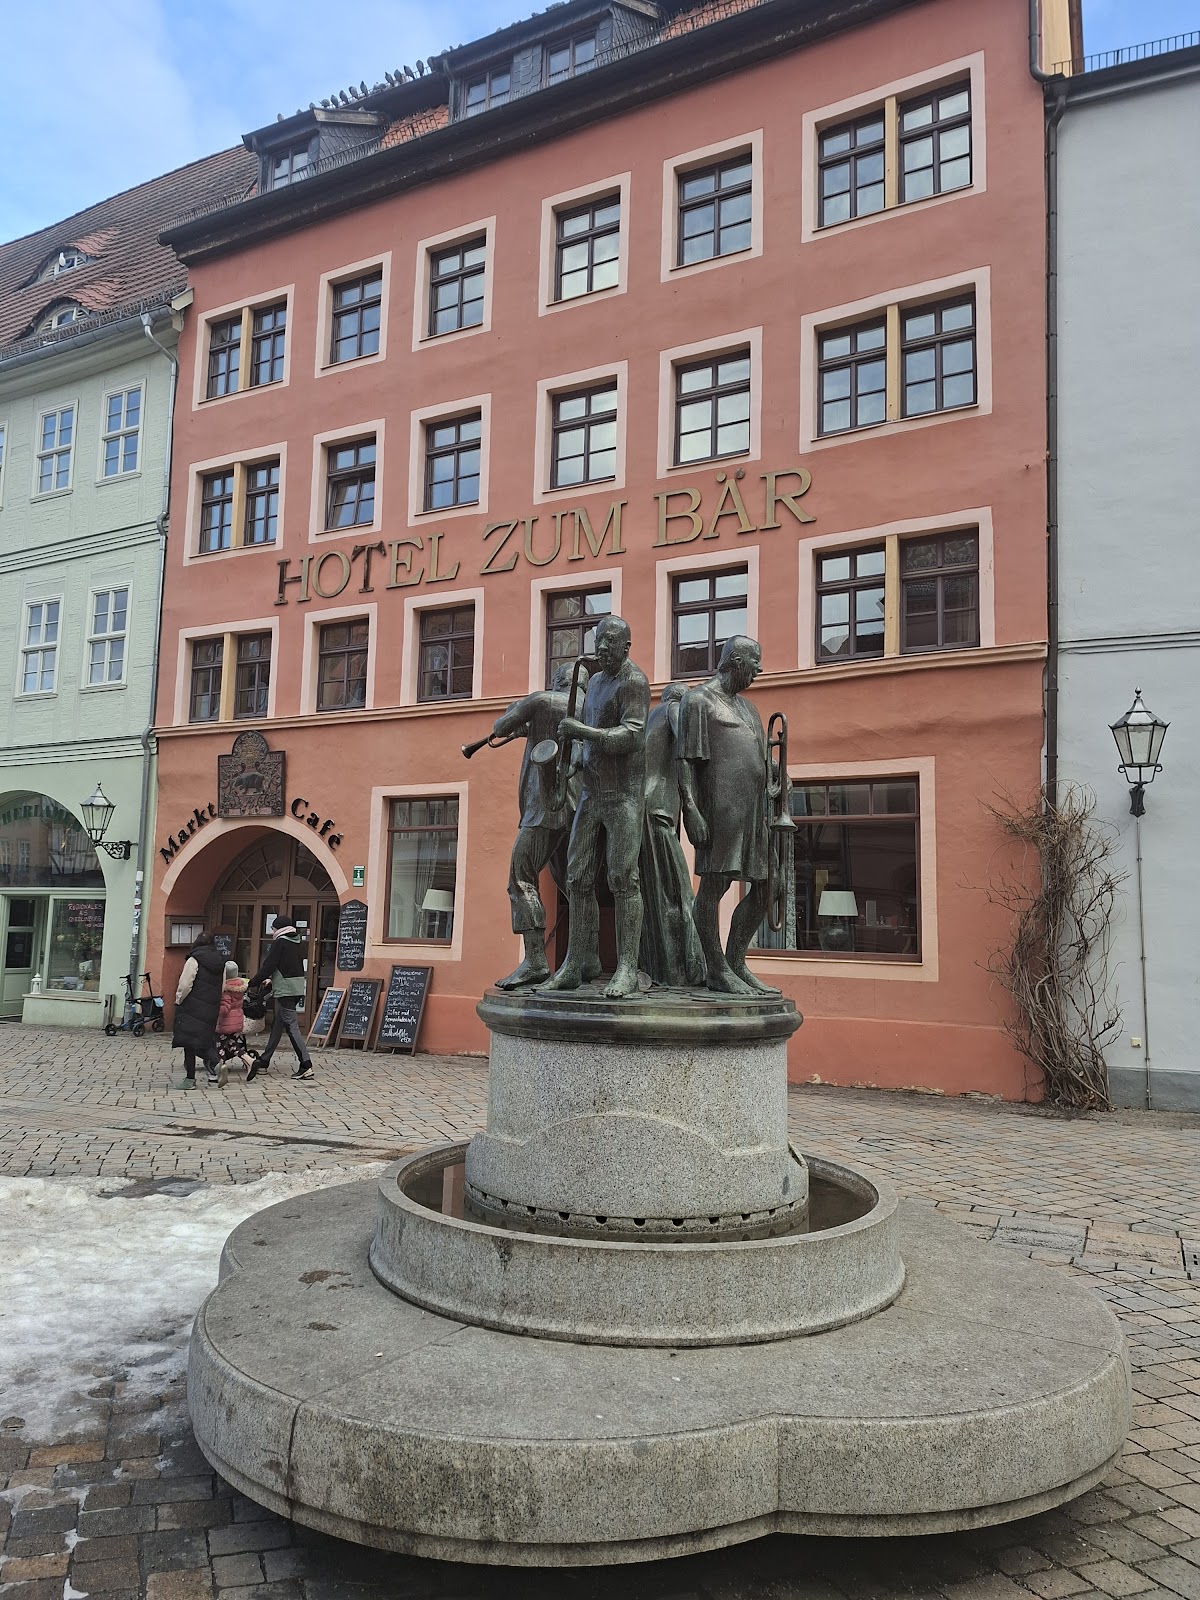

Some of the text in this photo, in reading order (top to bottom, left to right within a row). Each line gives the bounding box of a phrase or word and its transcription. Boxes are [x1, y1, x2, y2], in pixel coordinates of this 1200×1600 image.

[275, 467, 817, 605] HOTEL ZUM BÄR
[159, 798, 344, 864] Markt Café
